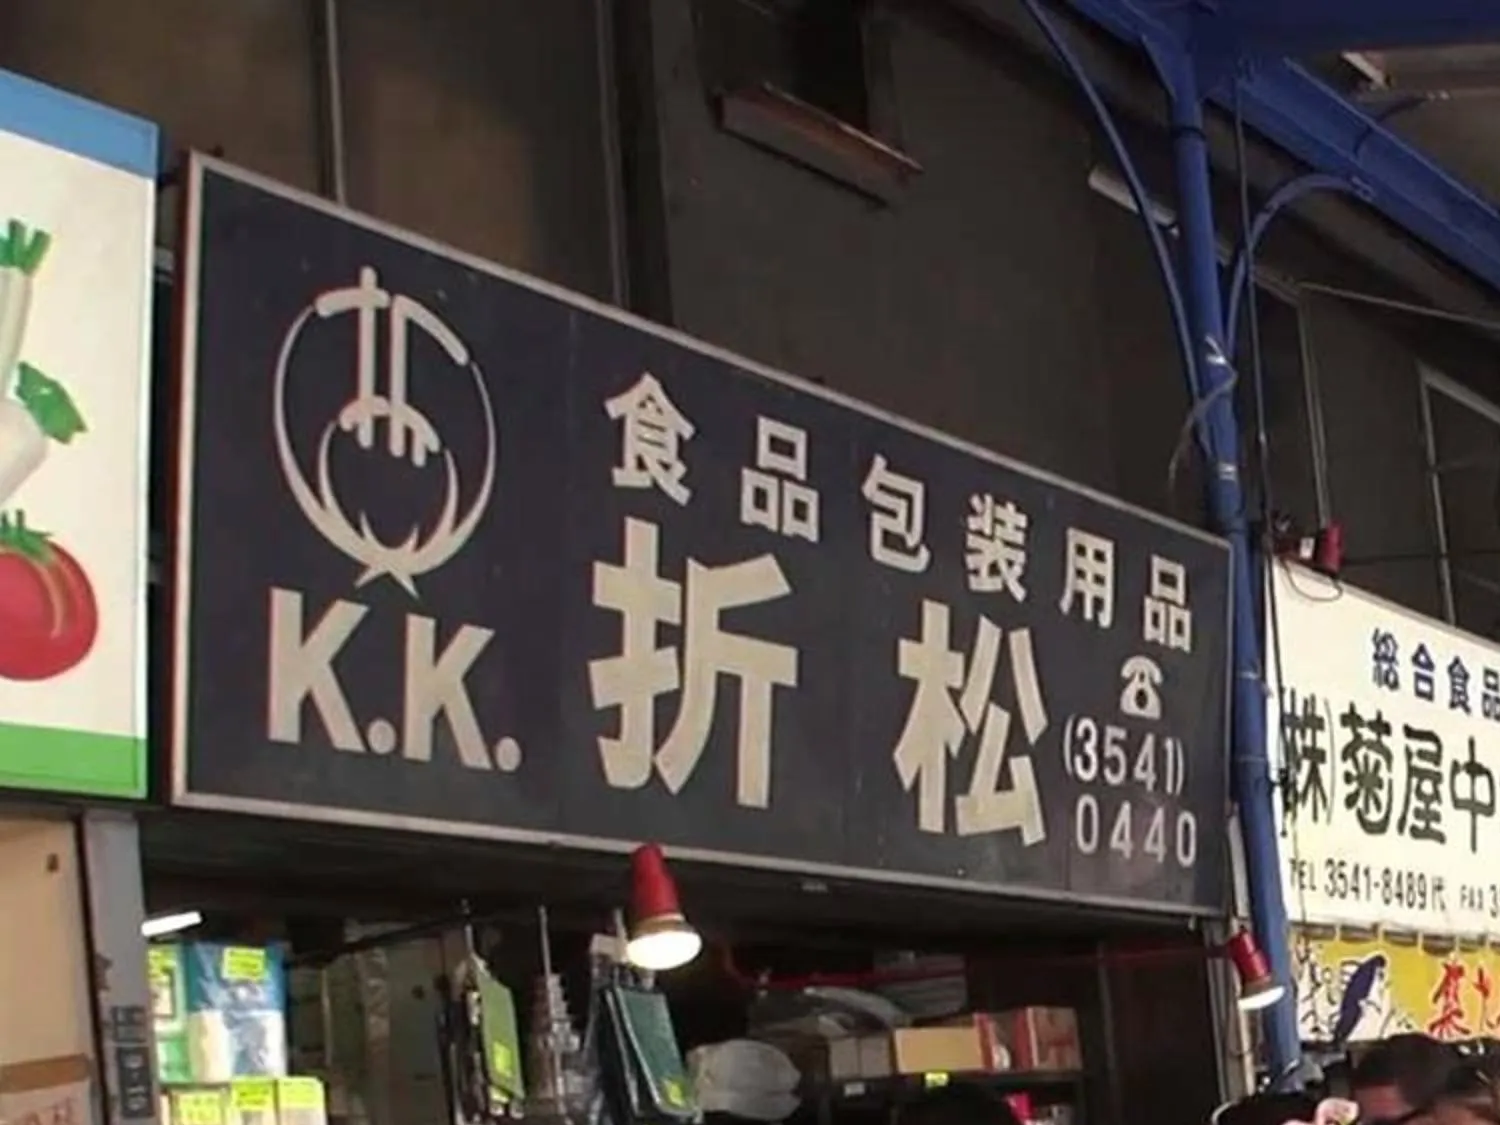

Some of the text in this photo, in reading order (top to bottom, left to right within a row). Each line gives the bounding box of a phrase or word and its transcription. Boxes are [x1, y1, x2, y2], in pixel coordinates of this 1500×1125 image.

[605, 371, 1192, 654] 食品包装用品
[267, 587, 521, 773] K.K.
[588, 516, 1048, 846] 折松
[1063, 713, 1185, 796] (3541)
[1074, 795, 1197, 868] 0440
